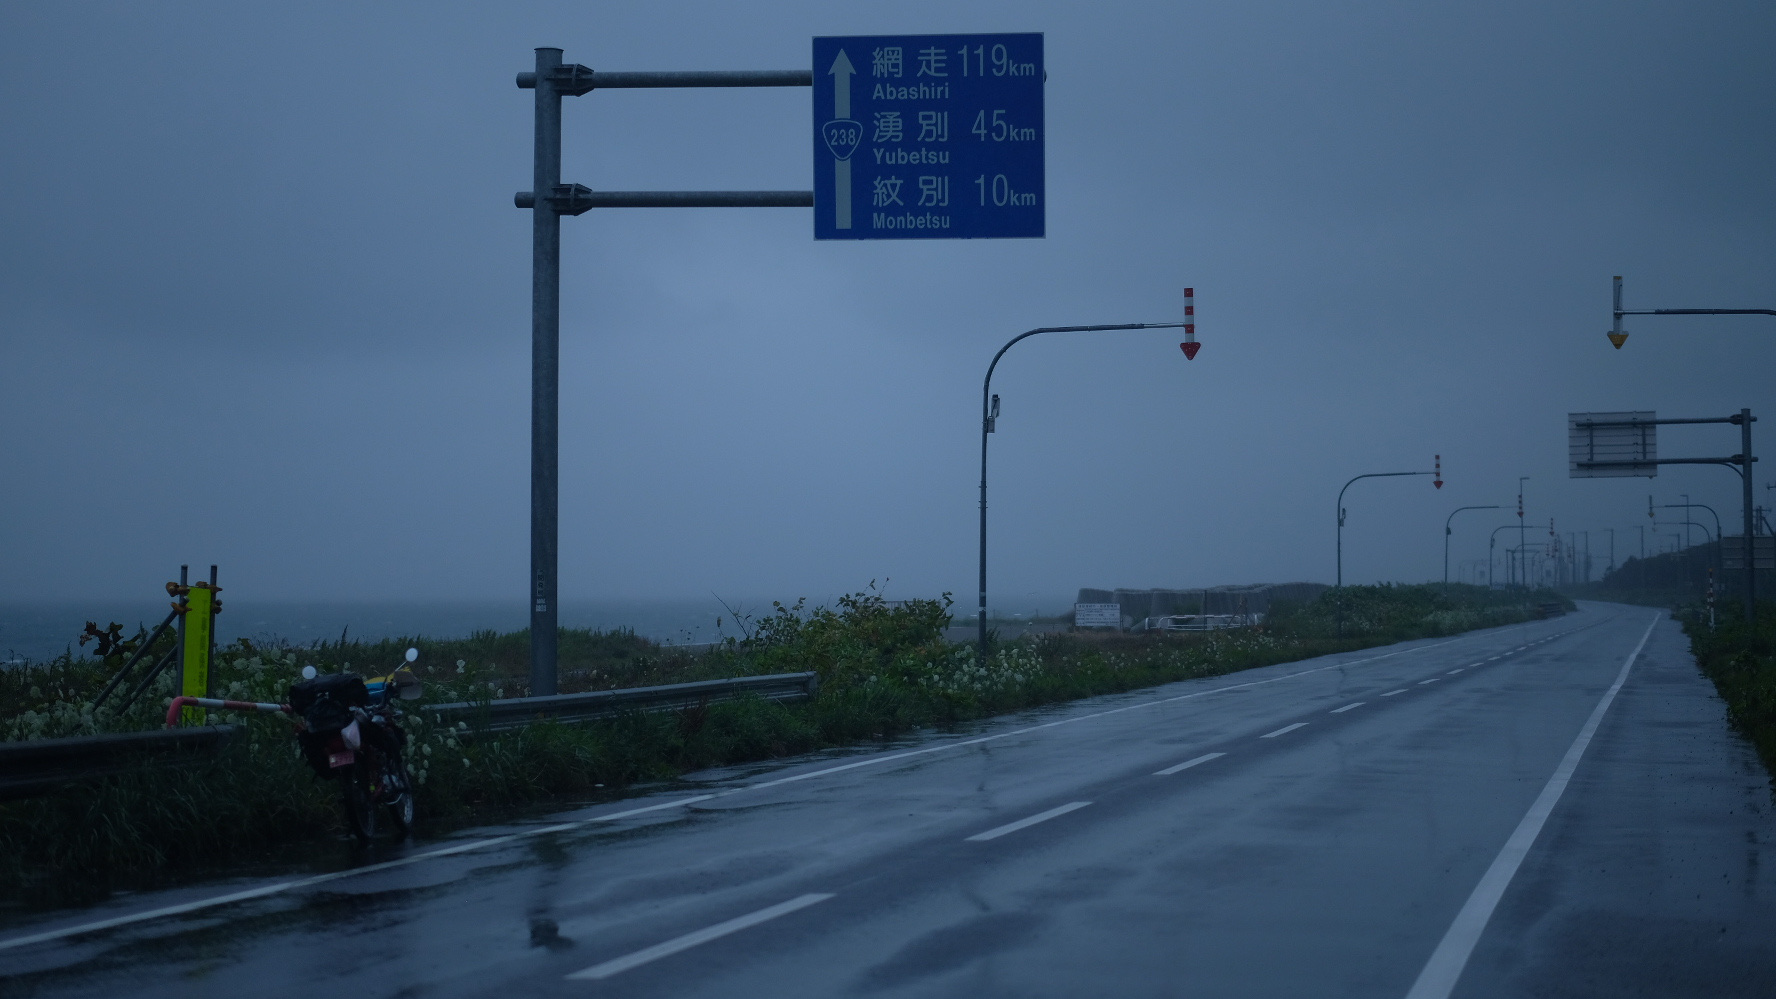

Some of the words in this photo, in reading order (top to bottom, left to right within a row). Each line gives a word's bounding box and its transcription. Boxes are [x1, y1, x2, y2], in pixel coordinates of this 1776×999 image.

[872, 46, 948, 78] 網走
[958, 44, 1034, 76] 119km
[873, 82, 948, 99] Abashiri
[873, 111, 947, 142] 湧別
[972, 110, 1035, 141] 45km
[830, 129, 856, 146] 238
[873, 148, 949, 164] Yubetsu
[873, 176, 948, 207] 紋別
[975, 174, 1035, 206] 10km
[873, 212, 949, 229] Monbetsu
